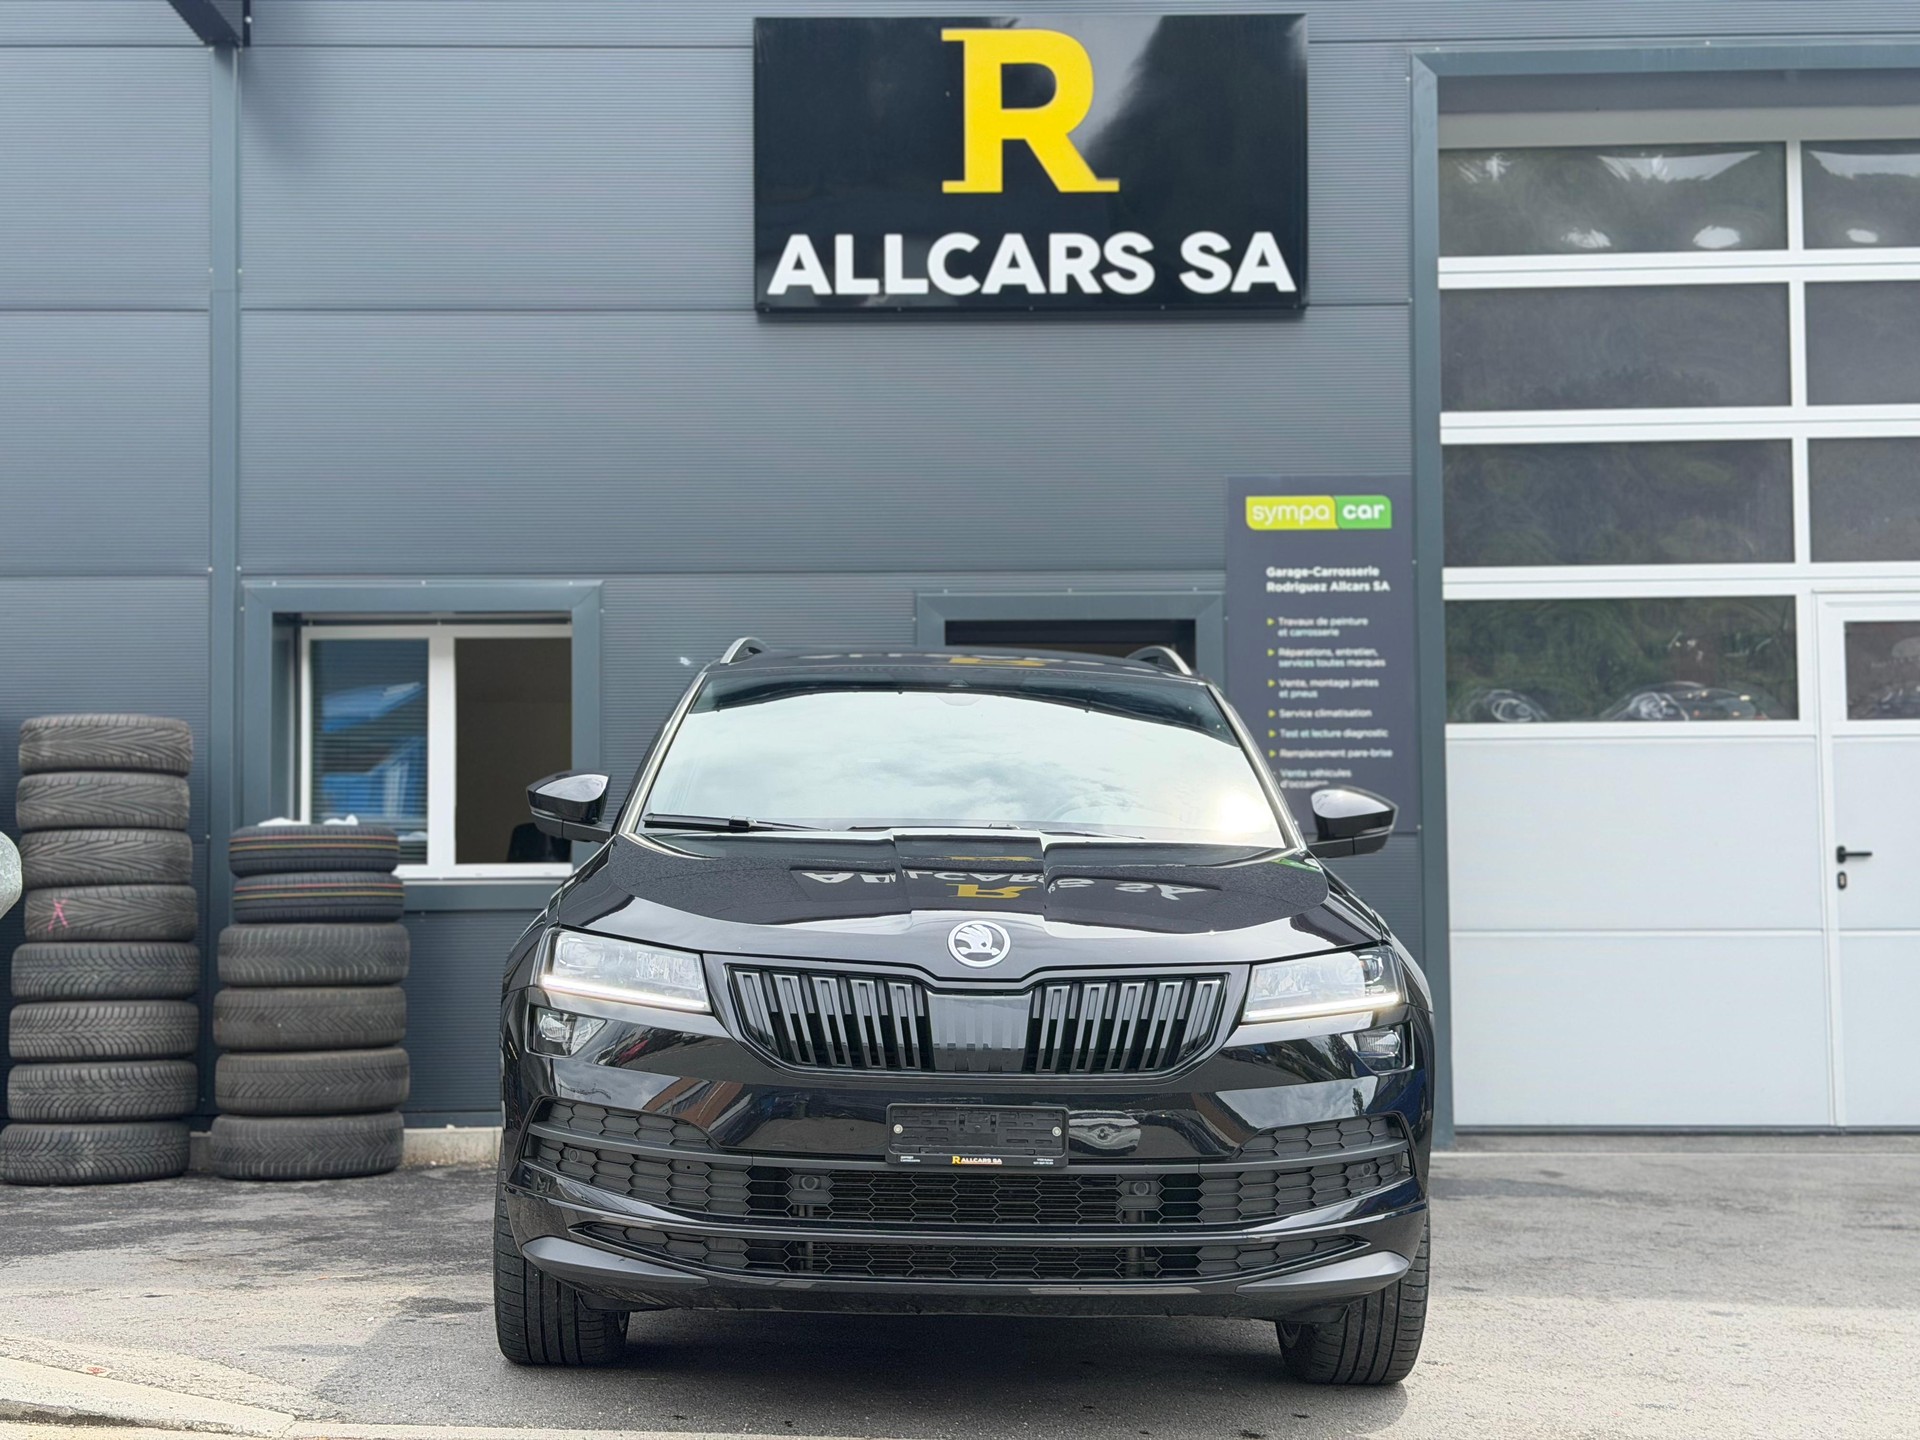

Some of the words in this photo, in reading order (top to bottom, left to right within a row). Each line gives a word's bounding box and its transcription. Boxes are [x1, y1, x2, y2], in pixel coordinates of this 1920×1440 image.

[941, 28, 1120, 193] R
[767, 231, 1155, 295] ALLCARS
[1179, 231, 1297, 293] SA
[1252, 504, 1330, 526] sympa
[1342, 504, 1385, 520] car
[1266, 565, 1380, 580] Garage-Carrosserie
[1266, 581, 1327, 594] Rodriguez
[1330, 581, 1370, 593] Allcars
[1373, 581, 1391, 592] SA
[1279, 617, 1314, 626] Travaux
[1316, 617, 1328, 626] de
[1330, 617, 1369, 628] peinture
[1278, 628, 1288, 637] et
[1289, 628, 1340, 637] carrosserie
[1278, 659, 1315, 668] services
[1316, 659, 1345, 668] toutes
[1346, 659, 1386, 669] marques
[1310, 679, 1350, 689] montage
[1351, 679, 1379, 689] jantes
[1279, 690, 1288, 699] et
[1290, 690, 1318, 699] pneus
[1279, 709, 1313, 718] Service
[1314, 709, 1373, 718] climatisation
[1280, 729, 1299, 738] Test
[1300, 729, 1310, 738] et
[1311, 729, 1341, 738] lecture
[1343, 729, 1389, 739] diagnostic
[1280, 749, 1346, 759] Remplacement
[1280, 769, 1308, 778] Vente
[952, 1155, 961, 1165] R
[961, 1157, 991, 1165] ALLCARS
